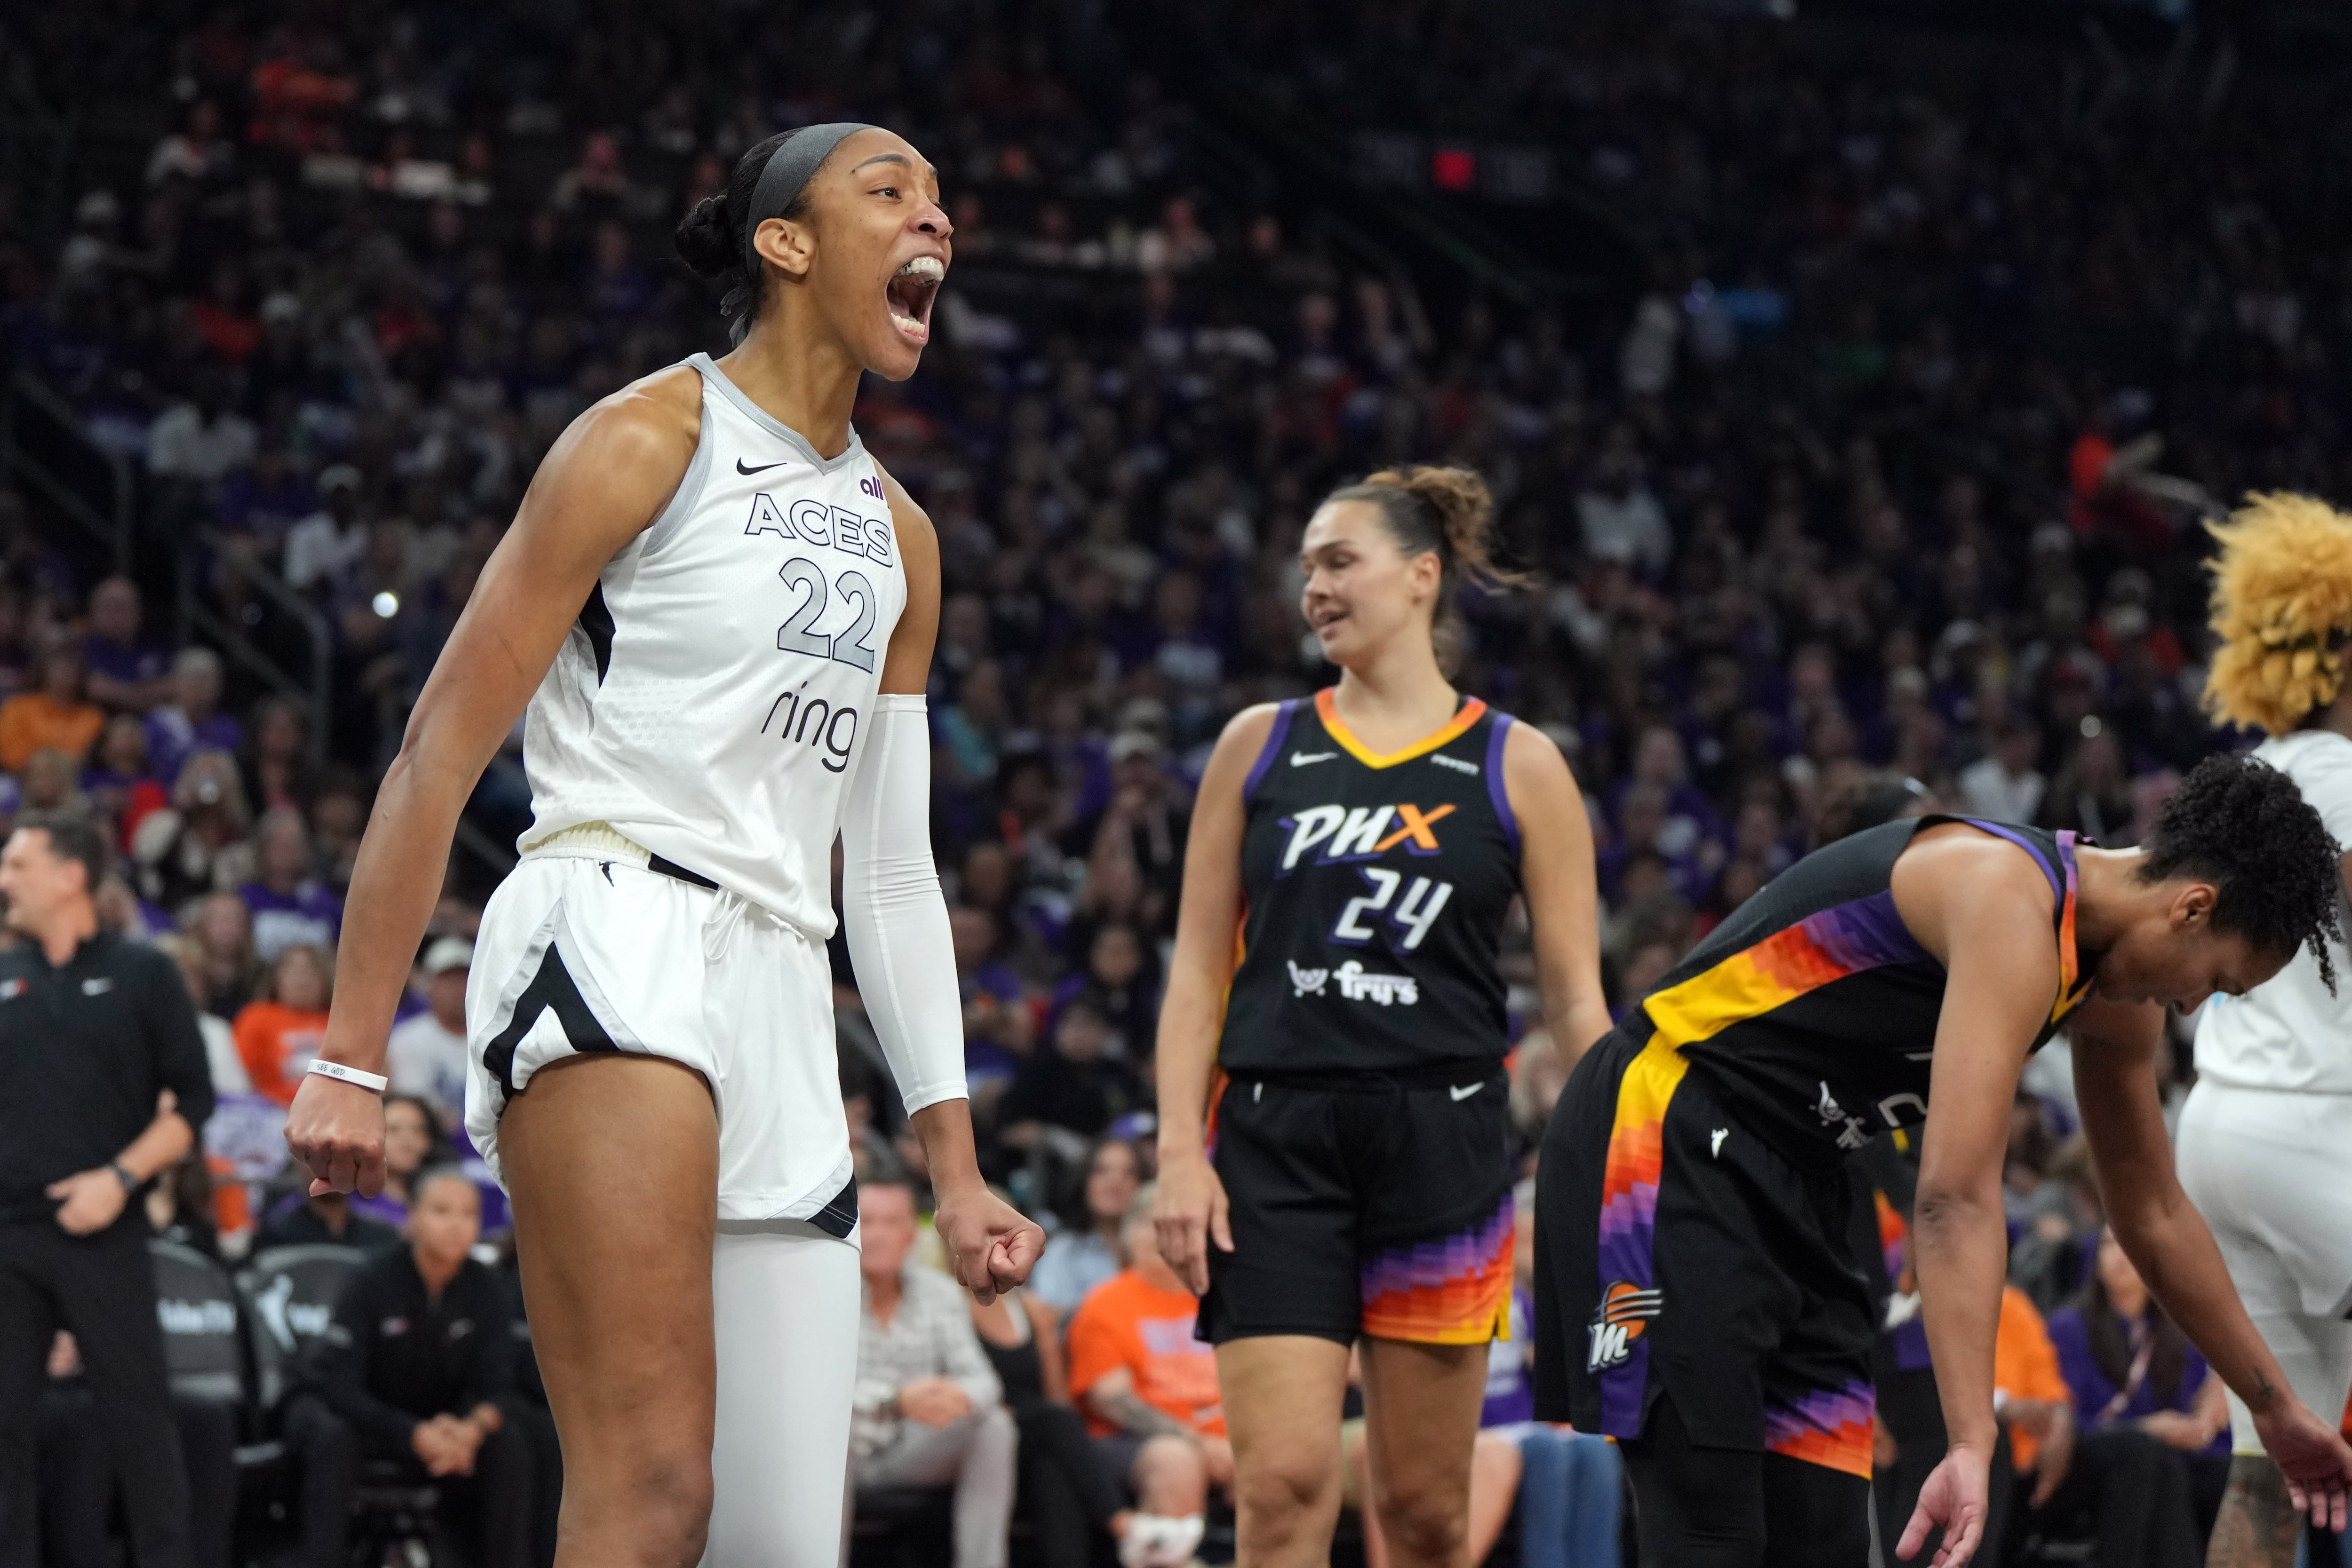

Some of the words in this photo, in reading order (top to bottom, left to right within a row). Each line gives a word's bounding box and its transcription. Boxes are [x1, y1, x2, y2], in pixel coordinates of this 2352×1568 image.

[860, 476, 883, 500] all
[744, 493, 893, 568] ACES
[777, 557, 876, 674] 22
[761, 681, 858, 773] ring
[1280, 803, 1456, 871] PHX
[1333, 867, 1453, 950] 24
[317, 1063, 328, 1072] SEE
